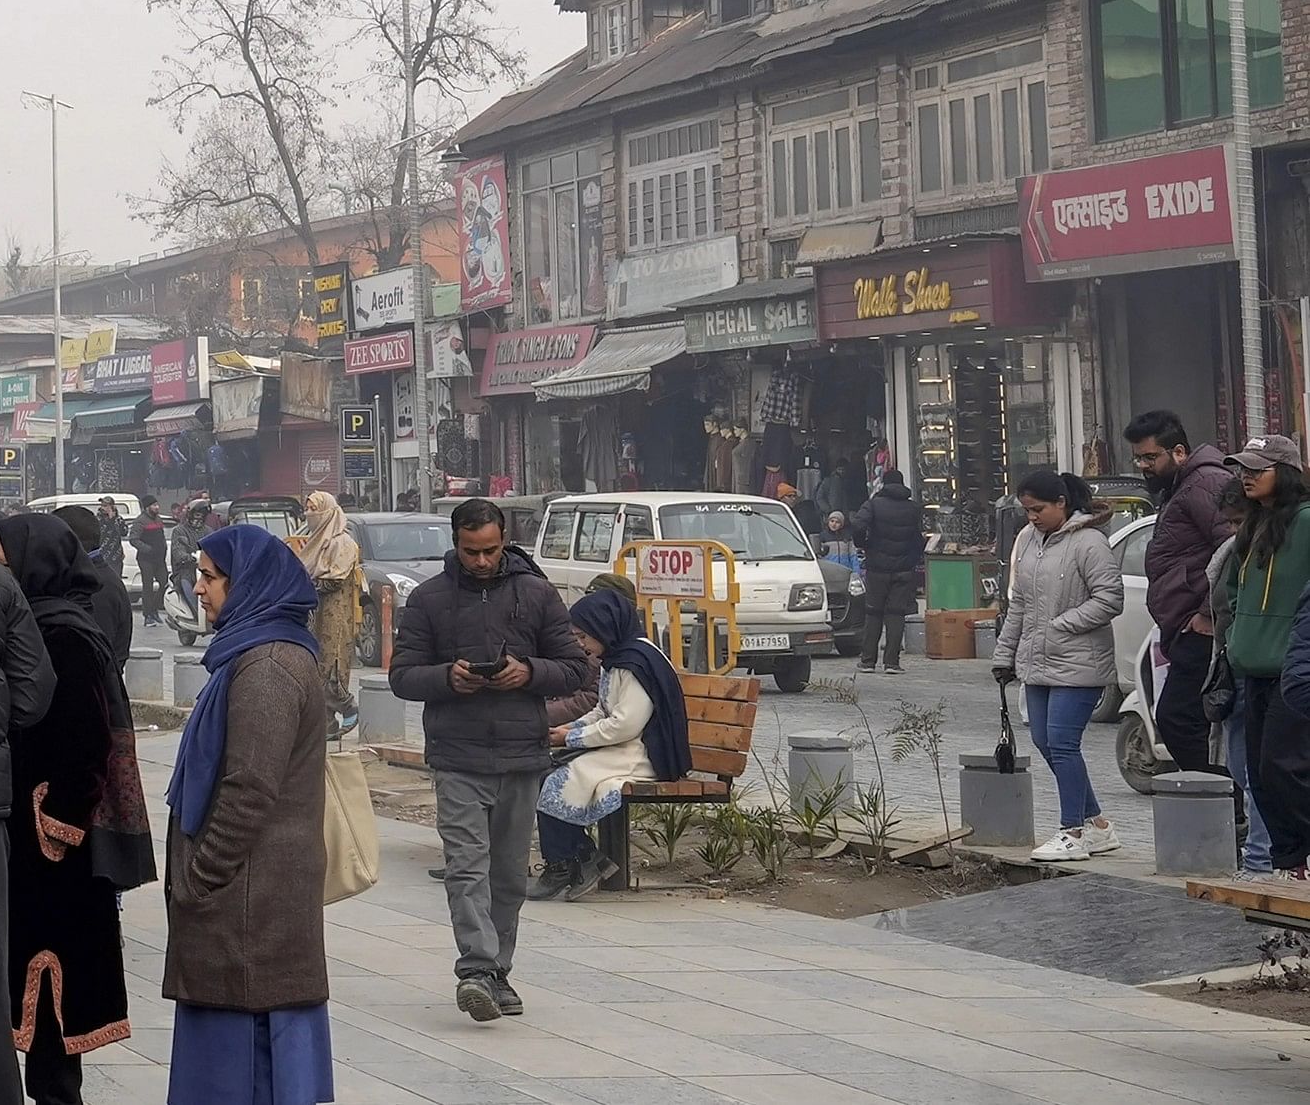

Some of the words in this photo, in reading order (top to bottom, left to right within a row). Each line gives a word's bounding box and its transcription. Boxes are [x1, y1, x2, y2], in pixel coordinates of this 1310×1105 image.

[1145, 177, 1215, 220] EXIDE
[1052, 189, 1129, 235] एक्साइड
[321, 298, 338, 314] DRY
[371, 285, 404, 311] Aerofit
[854, 274, 899, 319] Walk
[902, 267, 952, 314] Shoes
[705, 306, 757, 336] REGAL
[764, 299, 808, 332] SALE
[350, 346, 369, 367] ZEE
[370, 339, 406, 363] SPORTS
[521, 336, 547, 363] SINGH
[554, 334, 579, 360] SONS
[96, 359, 116, 378] BHAT
[119, 354, 152, 376] LUGGAG
[153, 371, 183, 384] TOURISTER
[154, 361, 183, 374] AMERICAN
[352, 415, 364, 432] P
[4, 449, 16, 466] P
[649, 549, 693, 575] STOP
